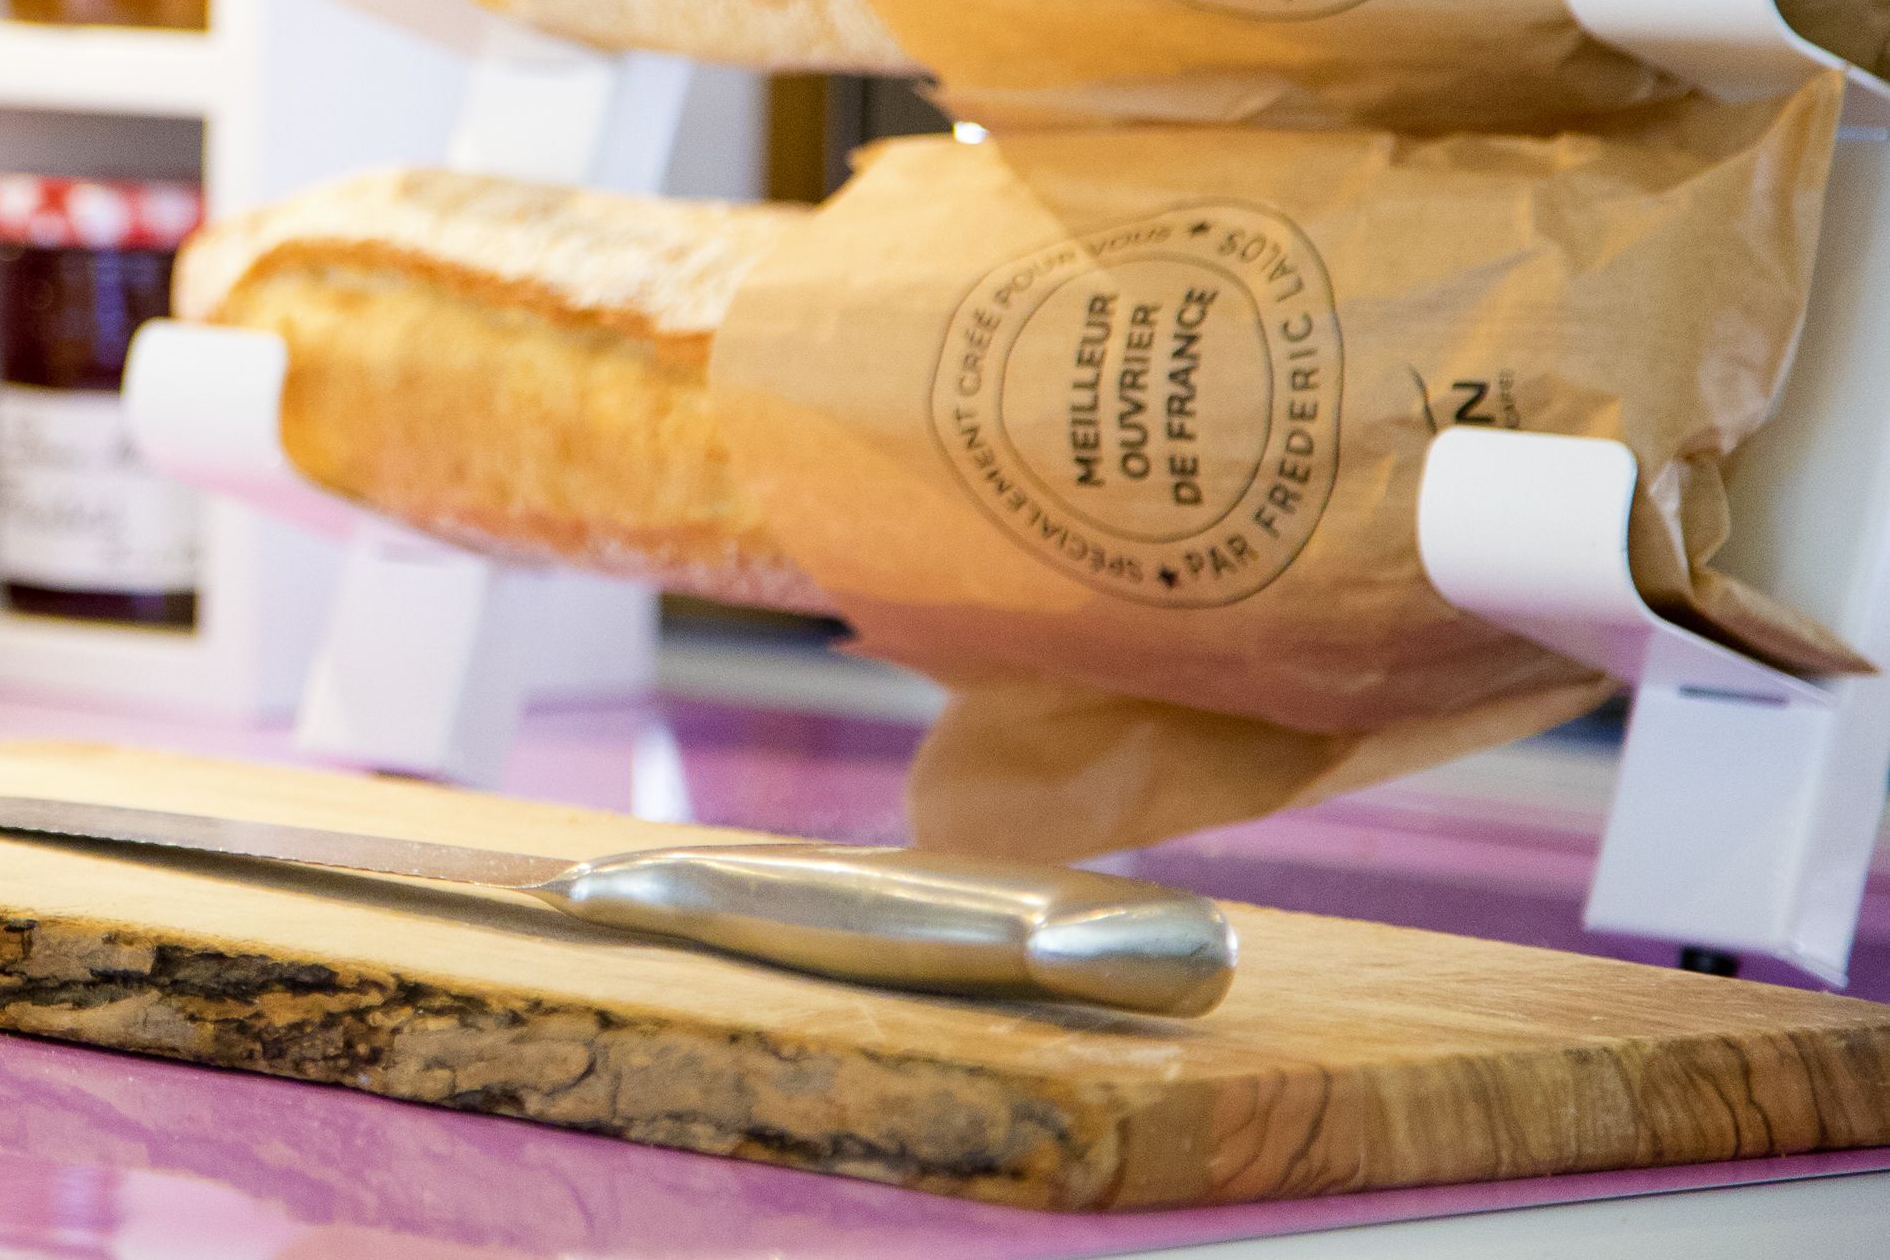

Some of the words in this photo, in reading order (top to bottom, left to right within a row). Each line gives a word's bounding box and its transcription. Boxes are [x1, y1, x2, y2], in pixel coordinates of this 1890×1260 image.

[1070, 291, 1119, 486] MEILLEUR
[1118, 303, 1162, 479] OUVRIER
[1166, 287, 1219, 440] FRANCE
[1169, 454, 1204, 505] DE
[1183, 533, 1259, 579] PAR
